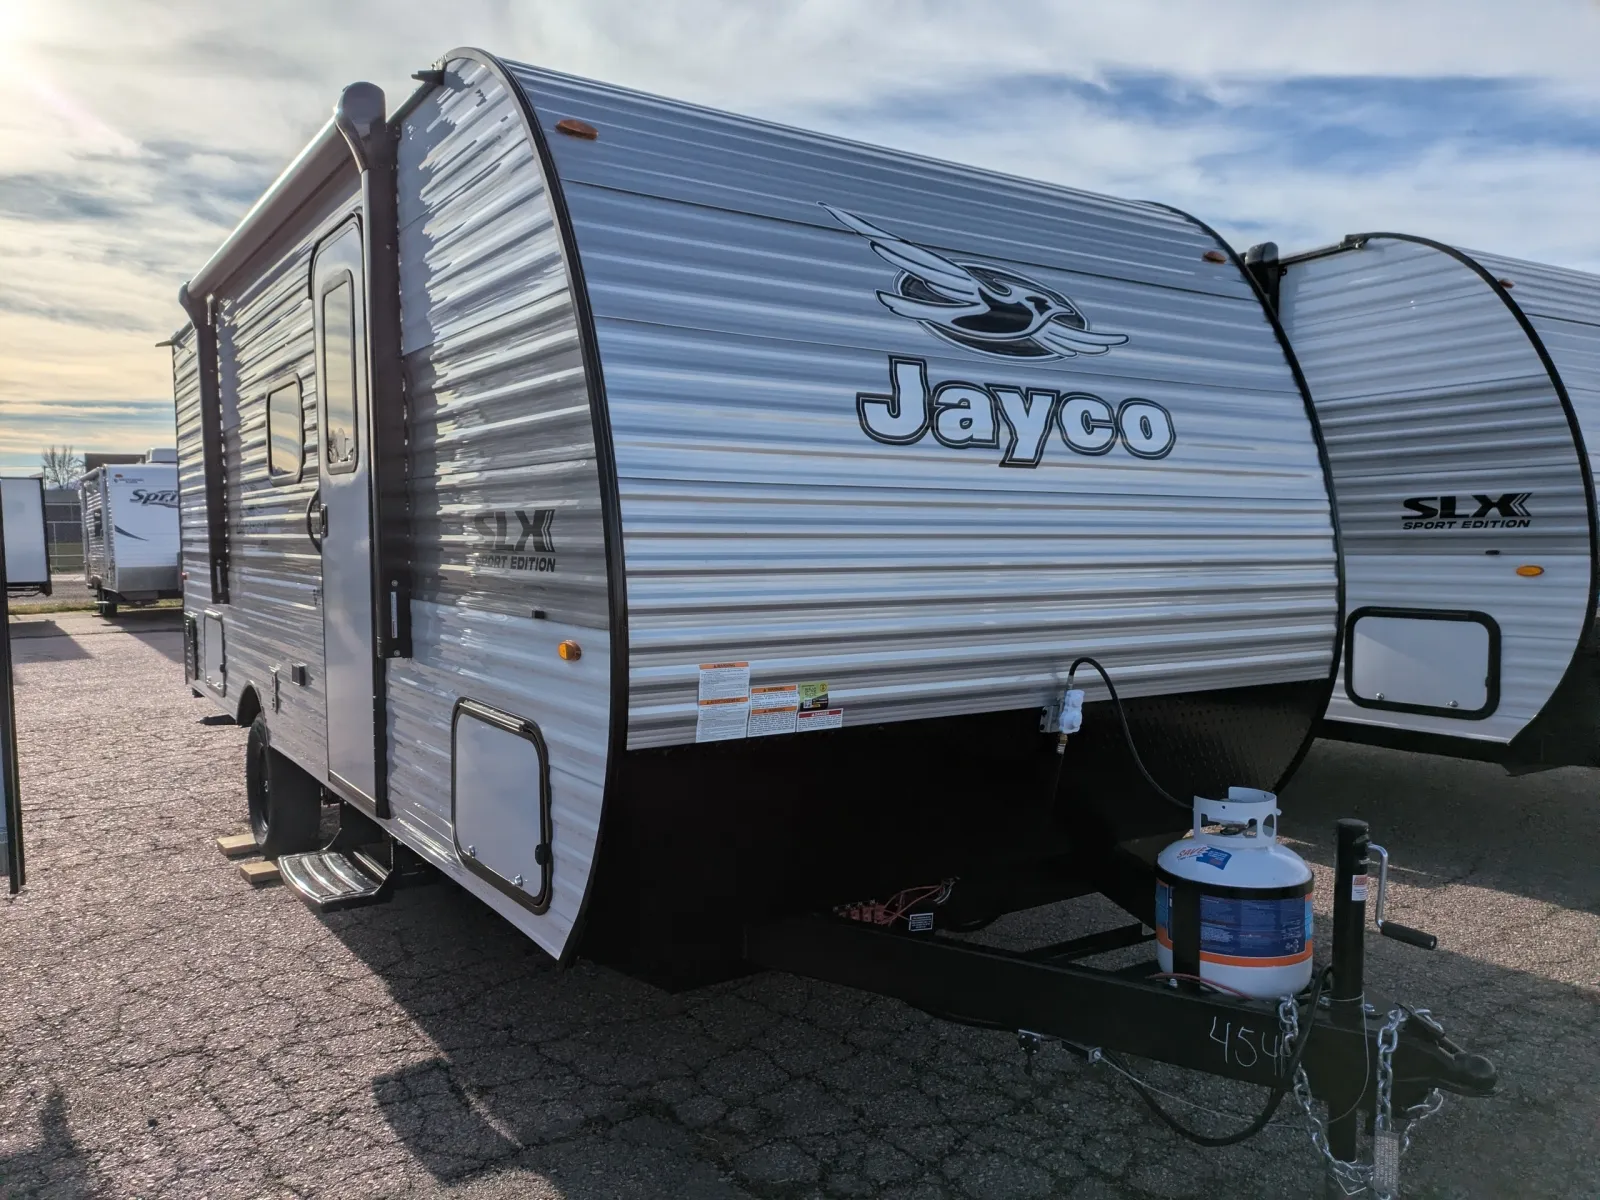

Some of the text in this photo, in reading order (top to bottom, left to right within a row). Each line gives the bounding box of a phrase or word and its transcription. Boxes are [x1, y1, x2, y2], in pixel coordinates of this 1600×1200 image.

[856, 355, 1177, 469] Jayco
[1401, 492, 1533, 520] SLX
[473, 509, 556, 552] SLX
[1402, 519, 1532, 530] SPORT EDITION
[476, 555, 556, 573] SPORT EDITION
